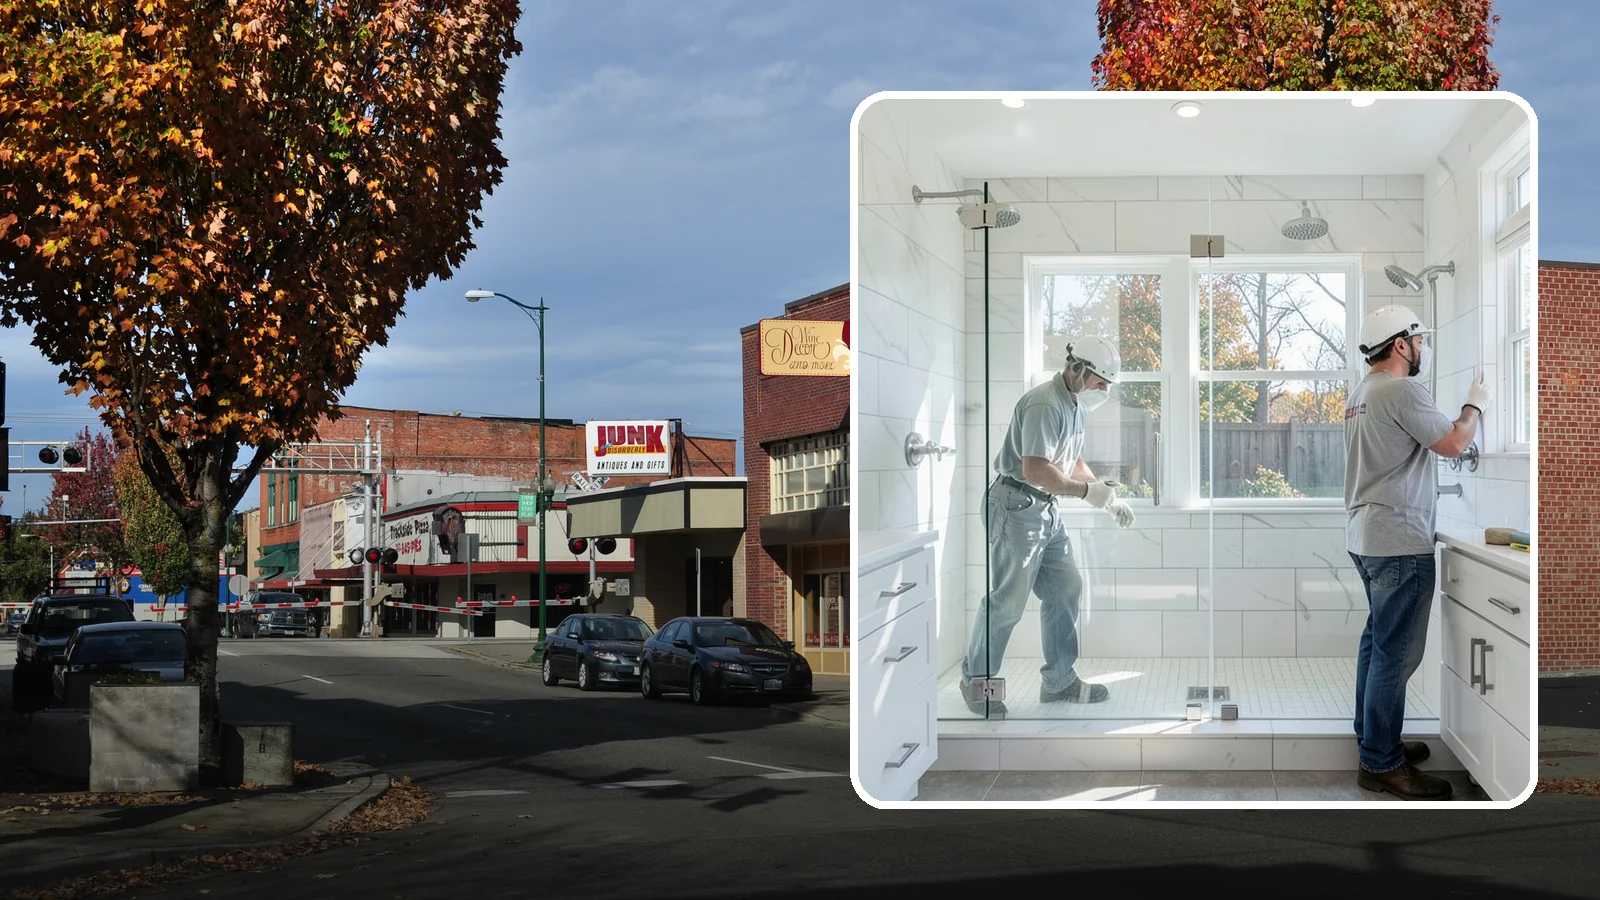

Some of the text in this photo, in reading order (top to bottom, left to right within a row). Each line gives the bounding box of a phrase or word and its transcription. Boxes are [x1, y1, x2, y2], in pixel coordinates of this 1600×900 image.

[765, 327, 830, 365] Decor
[595, 425, 665, 457] JUNK
[607, 446, 646, 454] DISORDERLY
[596, 460, 665, 470] ANTIQUES AND GIFTS
[390, 519, 429, 540] Trackside Pizza
